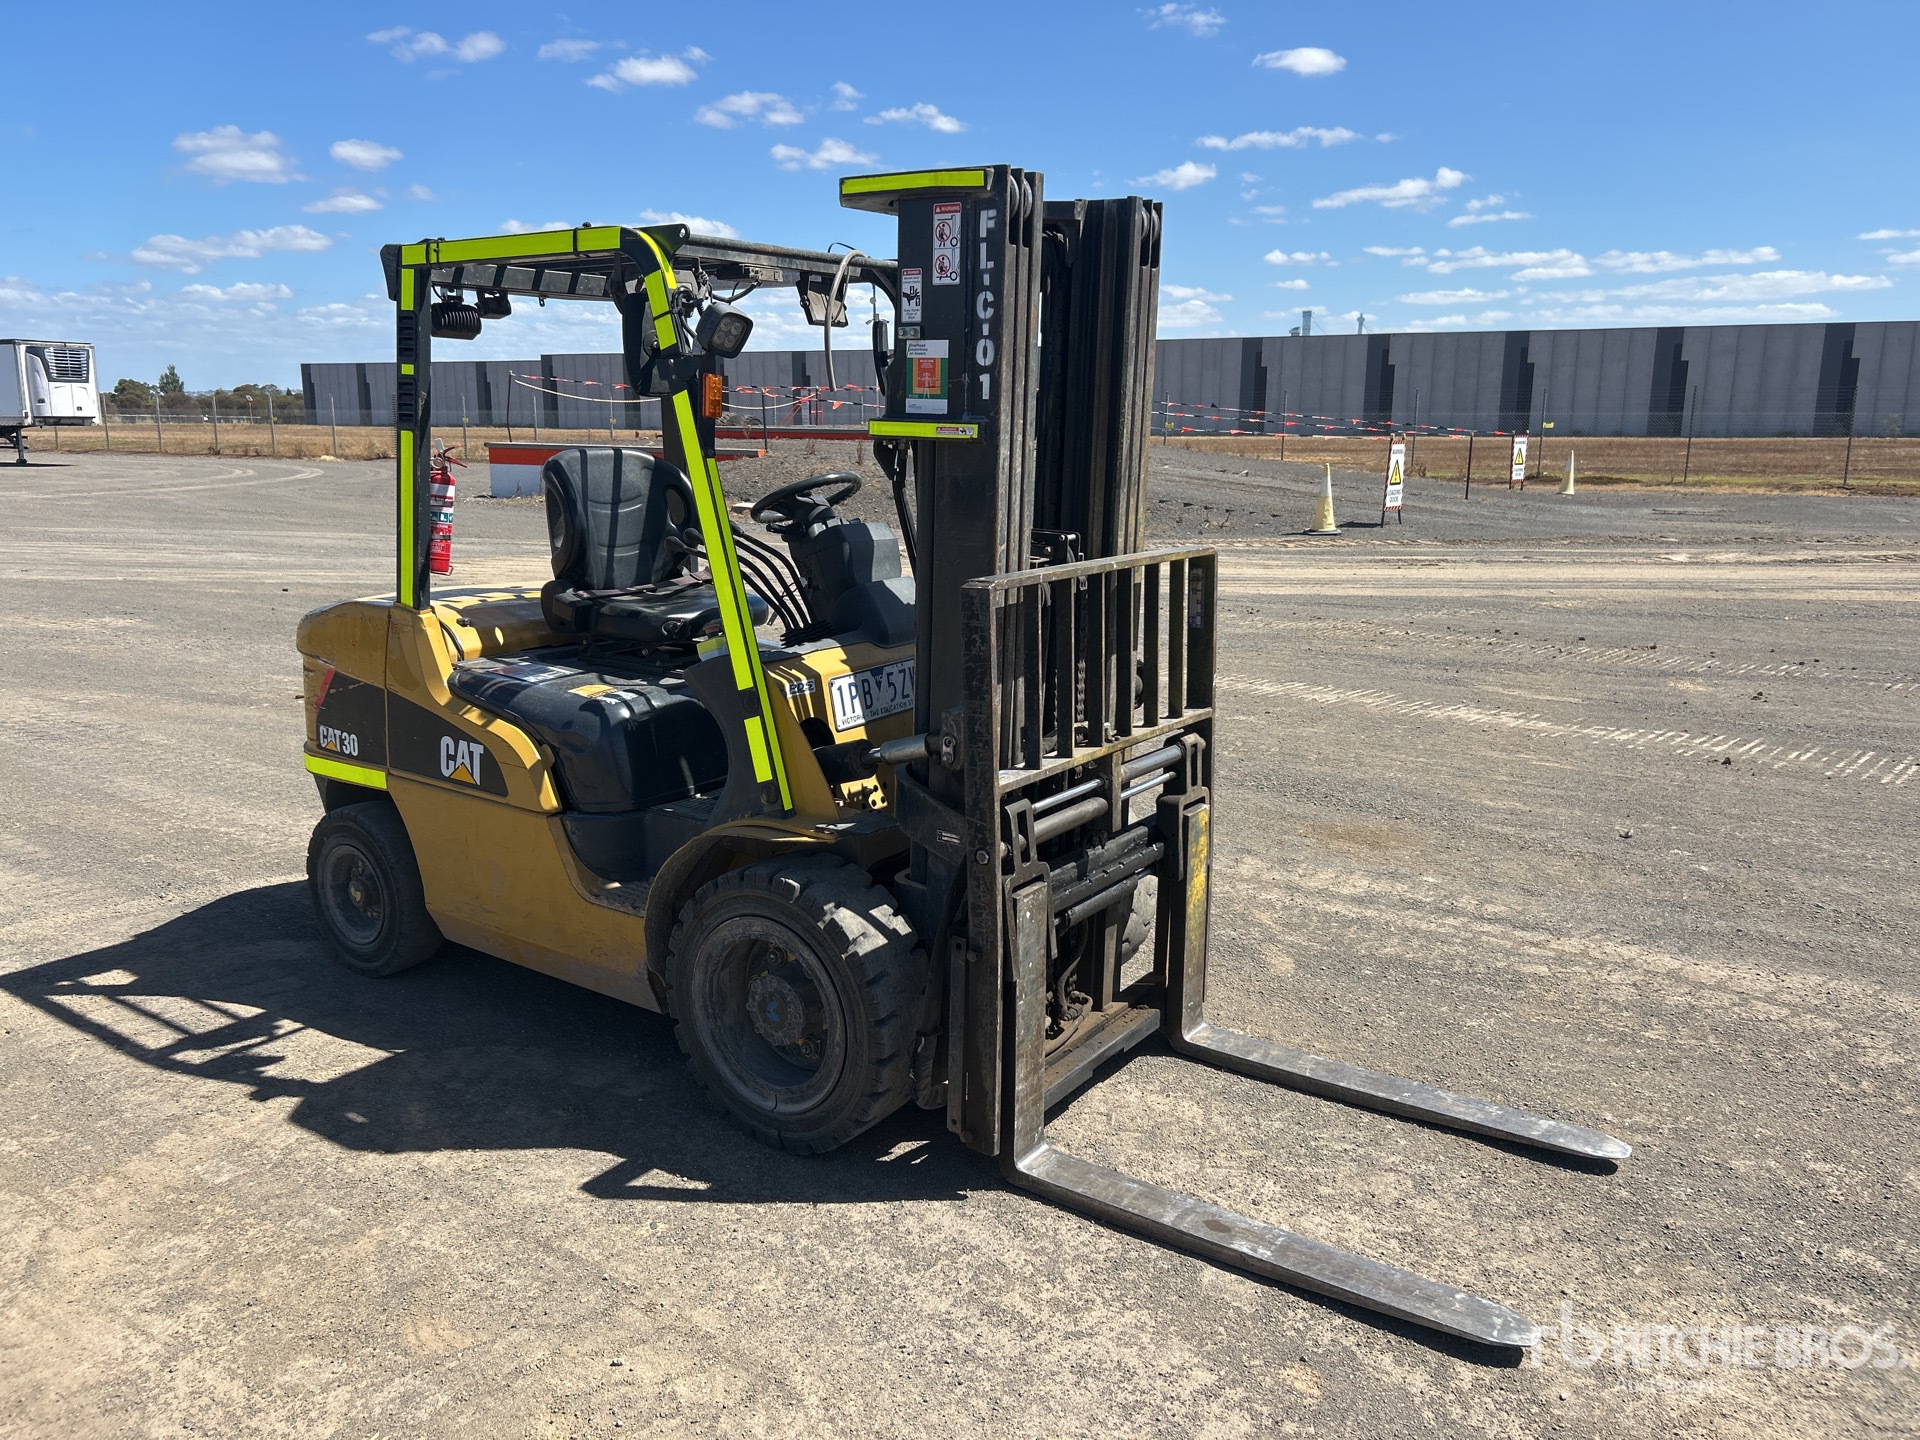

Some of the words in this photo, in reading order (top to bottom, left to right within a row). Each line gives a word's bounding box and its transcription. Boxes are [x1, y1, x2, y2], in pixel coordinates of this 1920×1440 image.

[837, 678, 874, 717] 1PB
[841, 713, 866, 726] VICTORIA
[881, 701, 908, 714] EDUCATION
[440, 735, 485, 786] CAT
